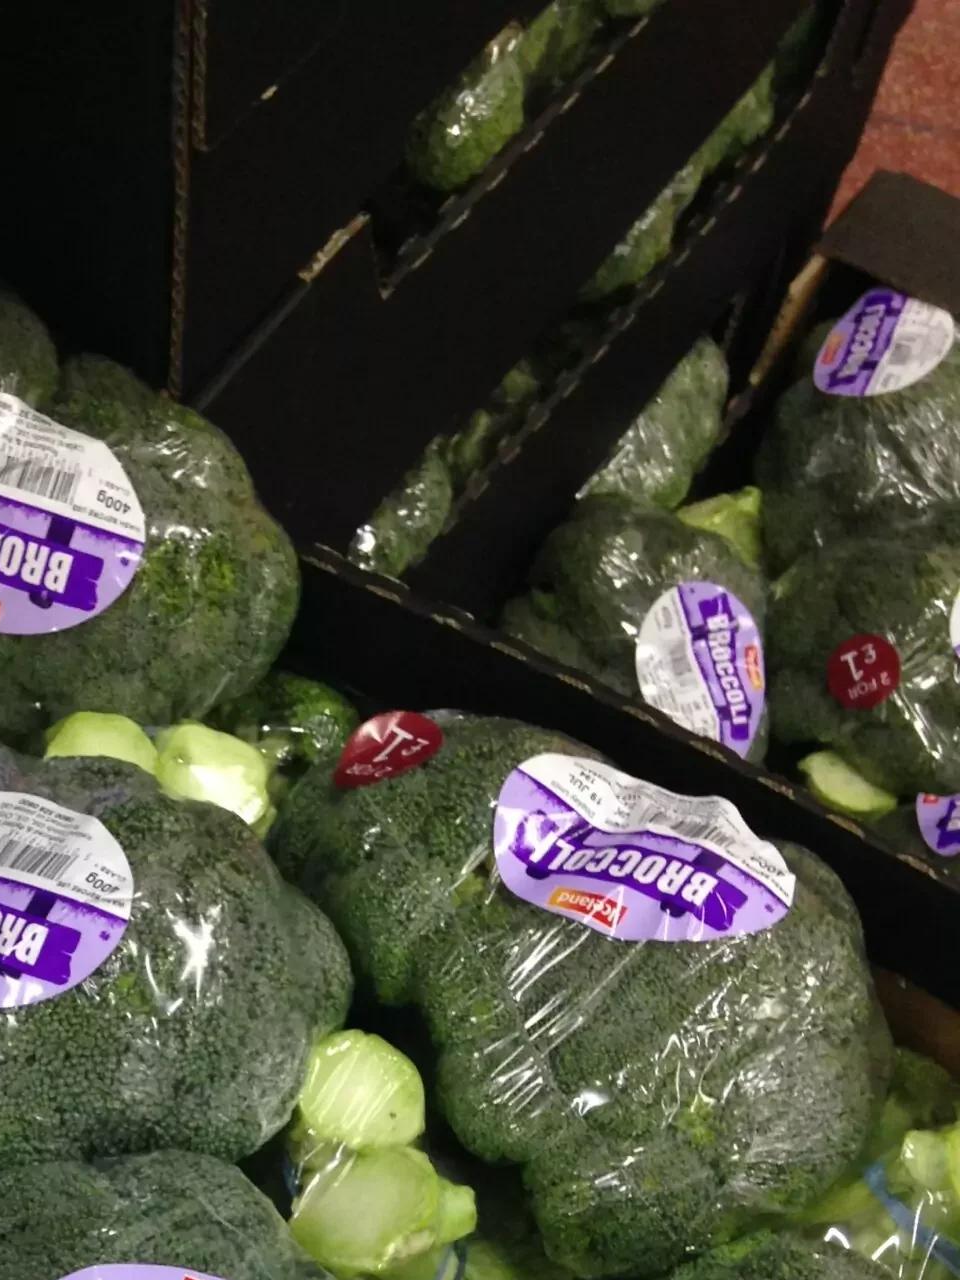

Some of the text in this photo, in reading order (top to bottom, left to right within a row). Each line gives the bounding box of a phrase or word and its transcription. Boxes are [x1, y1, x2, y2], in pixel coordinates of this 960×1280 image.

[96, 489, 131, 513] 400g
[707, 614, 747, 724] BROCCOLI
[840, 644, 876, 681] £1
[569, 773, 602, 805] 19 JUL
[529, 833, 718, 907] BROCCOLI
